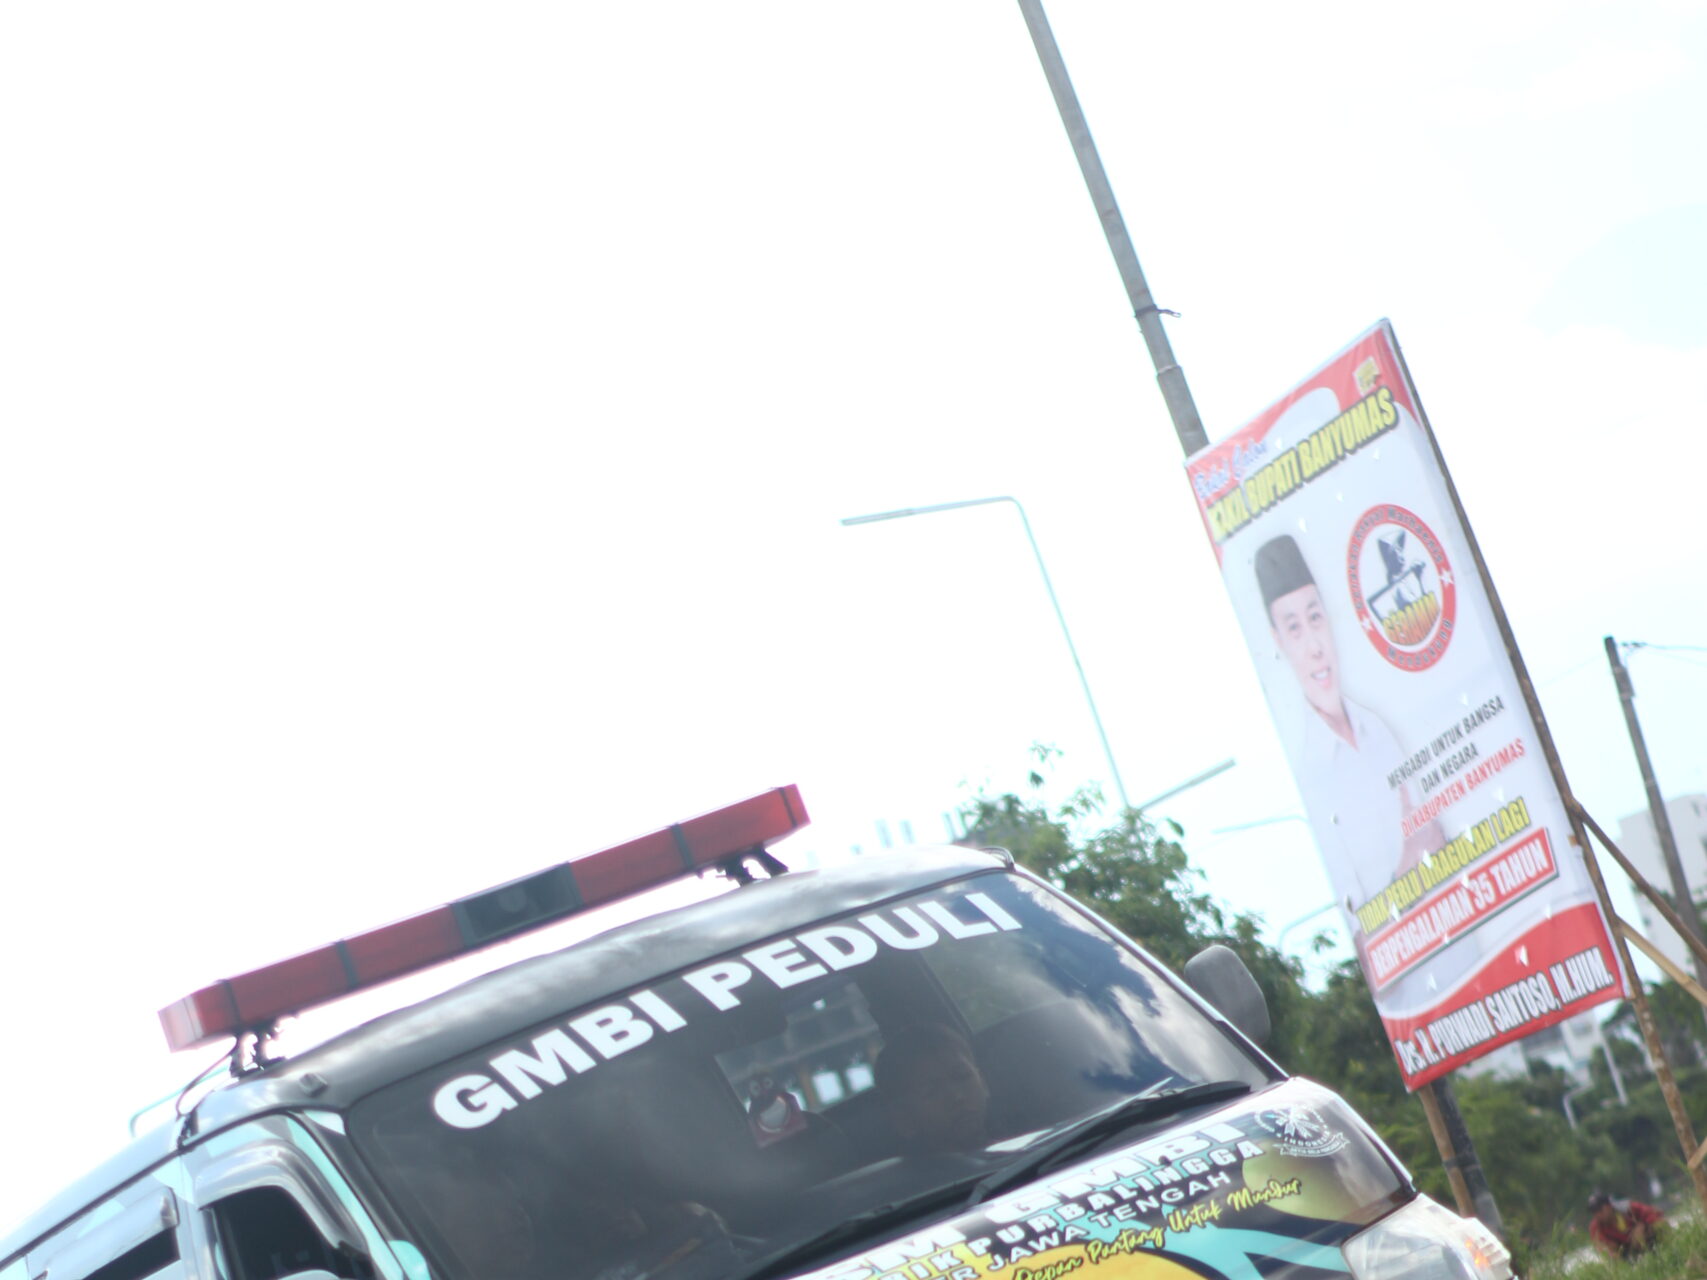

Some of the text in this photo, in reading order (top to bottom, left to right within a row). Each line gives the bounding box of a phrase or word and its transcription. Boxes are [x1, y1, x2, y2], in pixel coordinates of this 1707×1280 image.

[1244, 448, 1301, 515] BUPATI
[1297, 385, 1398, 481] BANYUMAS
[1387, 695, 1505, 790] MENGABDI UNTUK BANGSA
[1401, 737, 1526, 837] DI KABUPATEN BANYUMAS
[1421, 742, 1479, 793] DAN NEGARA
[1490, 796, 1532, 843] LAGI
[1368, 837, 1549, 979] BERPENGALAMAN 35 TAHUN
[433, 892, 1023, 1129] GMBI PEDULI
[1427, 996, 1498, 1059] PURWADI
[1485, 971, 1562, 1033] SANTOSO,
[967, 1139, 1266, 1257] PURBALINGGA
[984, 1121, 1246, 1224] GMBI
[987, 1224, 1090, 1272] JAWA
[1089, 1171, 1232, 1229] TENGAH
[1085, 1225, 1166, 1264] Pantang
[1167, 1199, 1223, 1234] Untuk
[1226, 1177, 1302, 1213] Mundur
